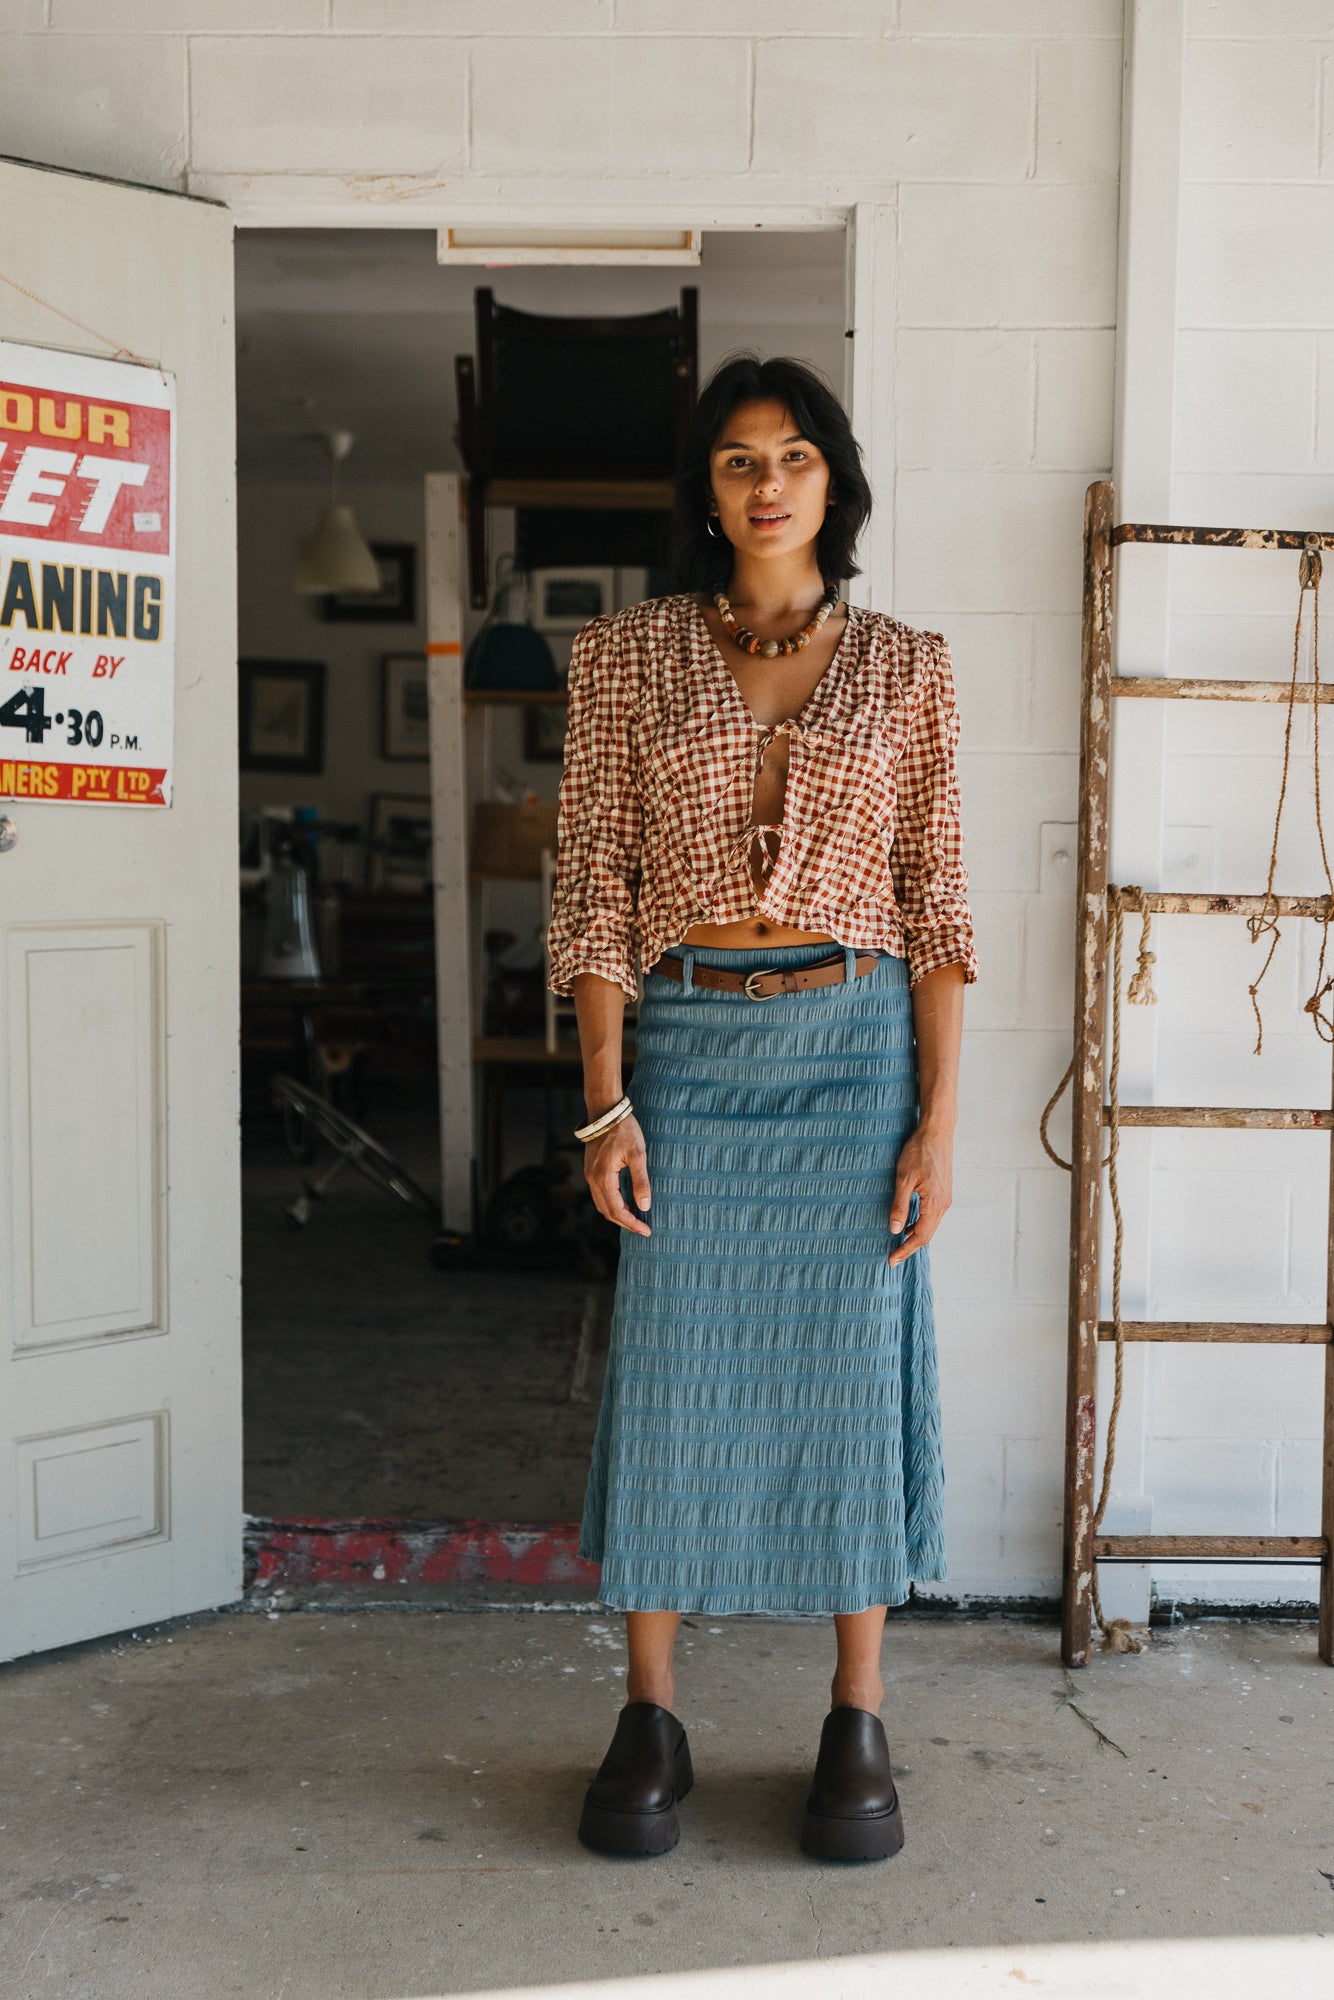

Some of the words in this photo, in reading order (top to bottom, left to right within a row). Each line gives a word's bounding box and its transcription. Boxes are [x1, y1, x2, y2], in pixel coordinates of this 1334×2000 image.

[0, 441, 151, 534] ET
[9, 647, 74, 676] BACK
[92, 654, 126, 679] BY
[110, 734, 143, 751] P.M.
[0, 762, 59, 796] NERS
[71, 767, 112, 799] PTY
[117, 770, 151, 801] LTD
